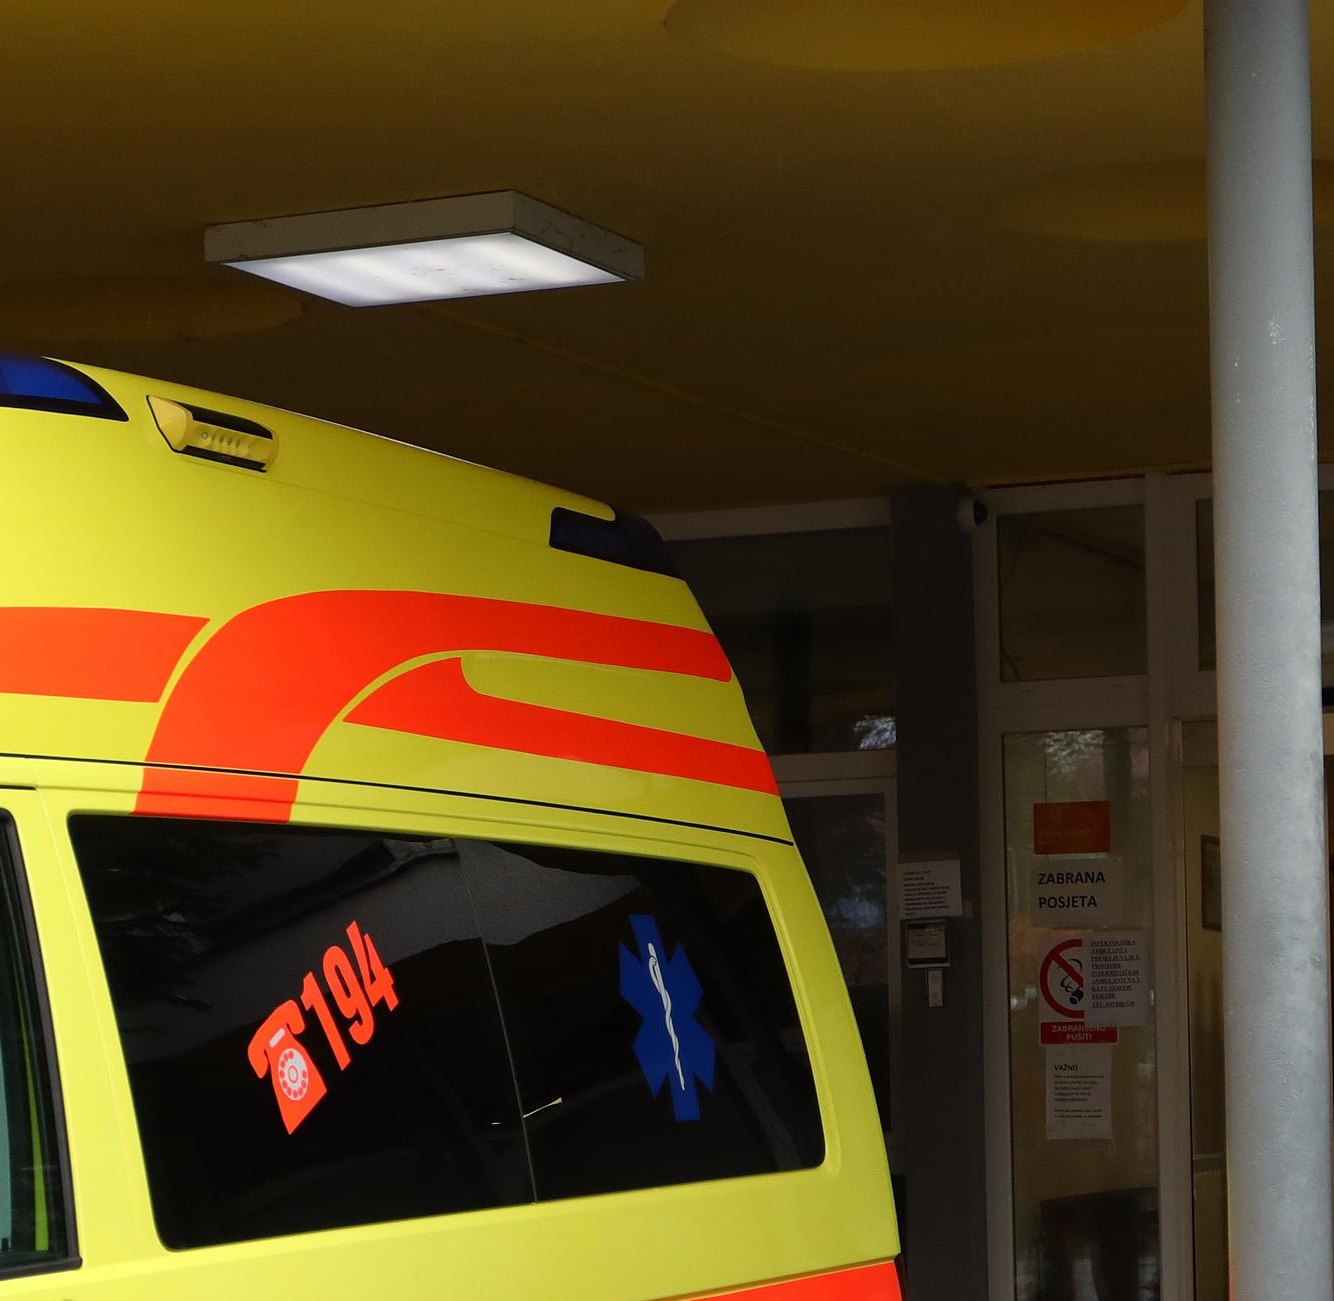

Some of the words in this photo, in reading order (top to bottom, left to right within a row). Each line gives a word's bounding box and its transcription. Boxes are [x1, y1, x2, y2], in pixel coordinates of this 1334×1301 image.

[1038, 871, 1106, 885] ZABRANA
[1038, 895, 1098, 909] POSJETA
[301, 920, 400, 1071] 194
[1066, 1032, 1092, 1041] PUŠITI
[1054, 1063, 1078, 1072] VAŽNO
